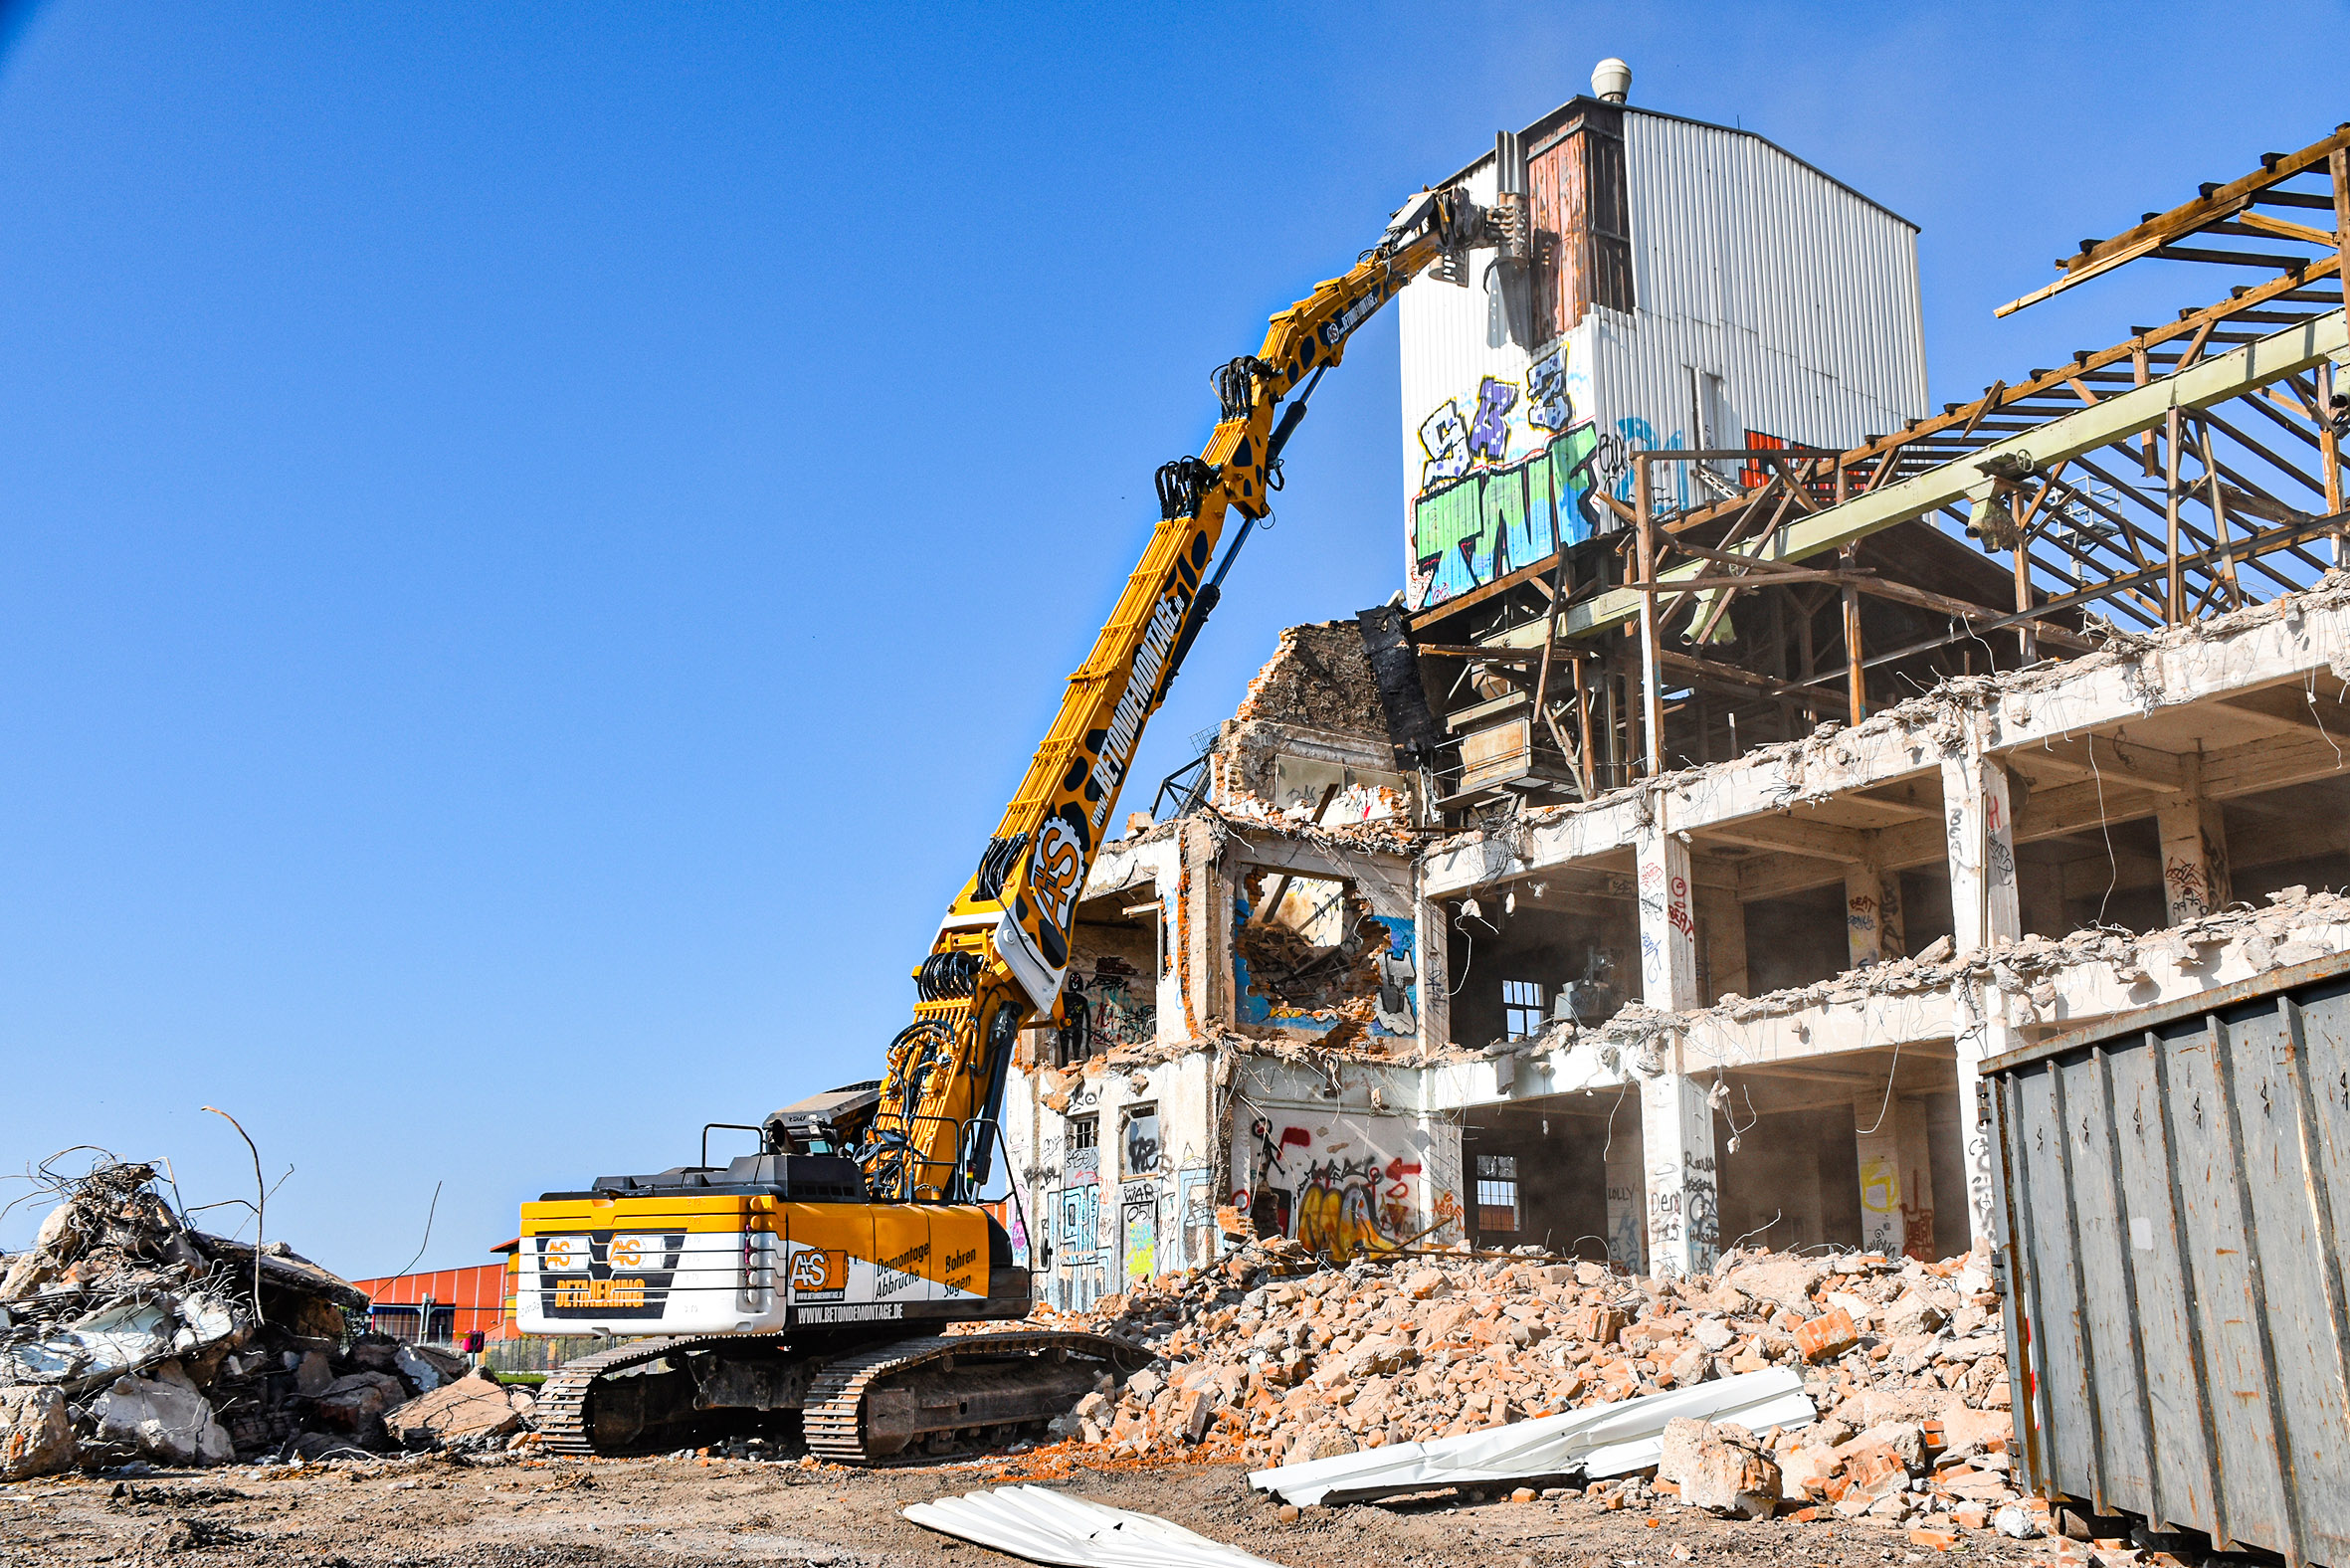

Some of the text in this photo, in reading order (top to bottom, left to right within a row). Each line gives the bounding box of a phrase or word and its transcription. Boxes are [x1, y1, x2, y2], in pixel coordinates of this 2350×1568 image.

[877, 1243, 977, 1277] Demontage Bohren
[876, 1266, 971, 1300] Abbrüche Sägen
[798, 1303, 903, 1324] WWW.BETONDEMONTAGE.DE
